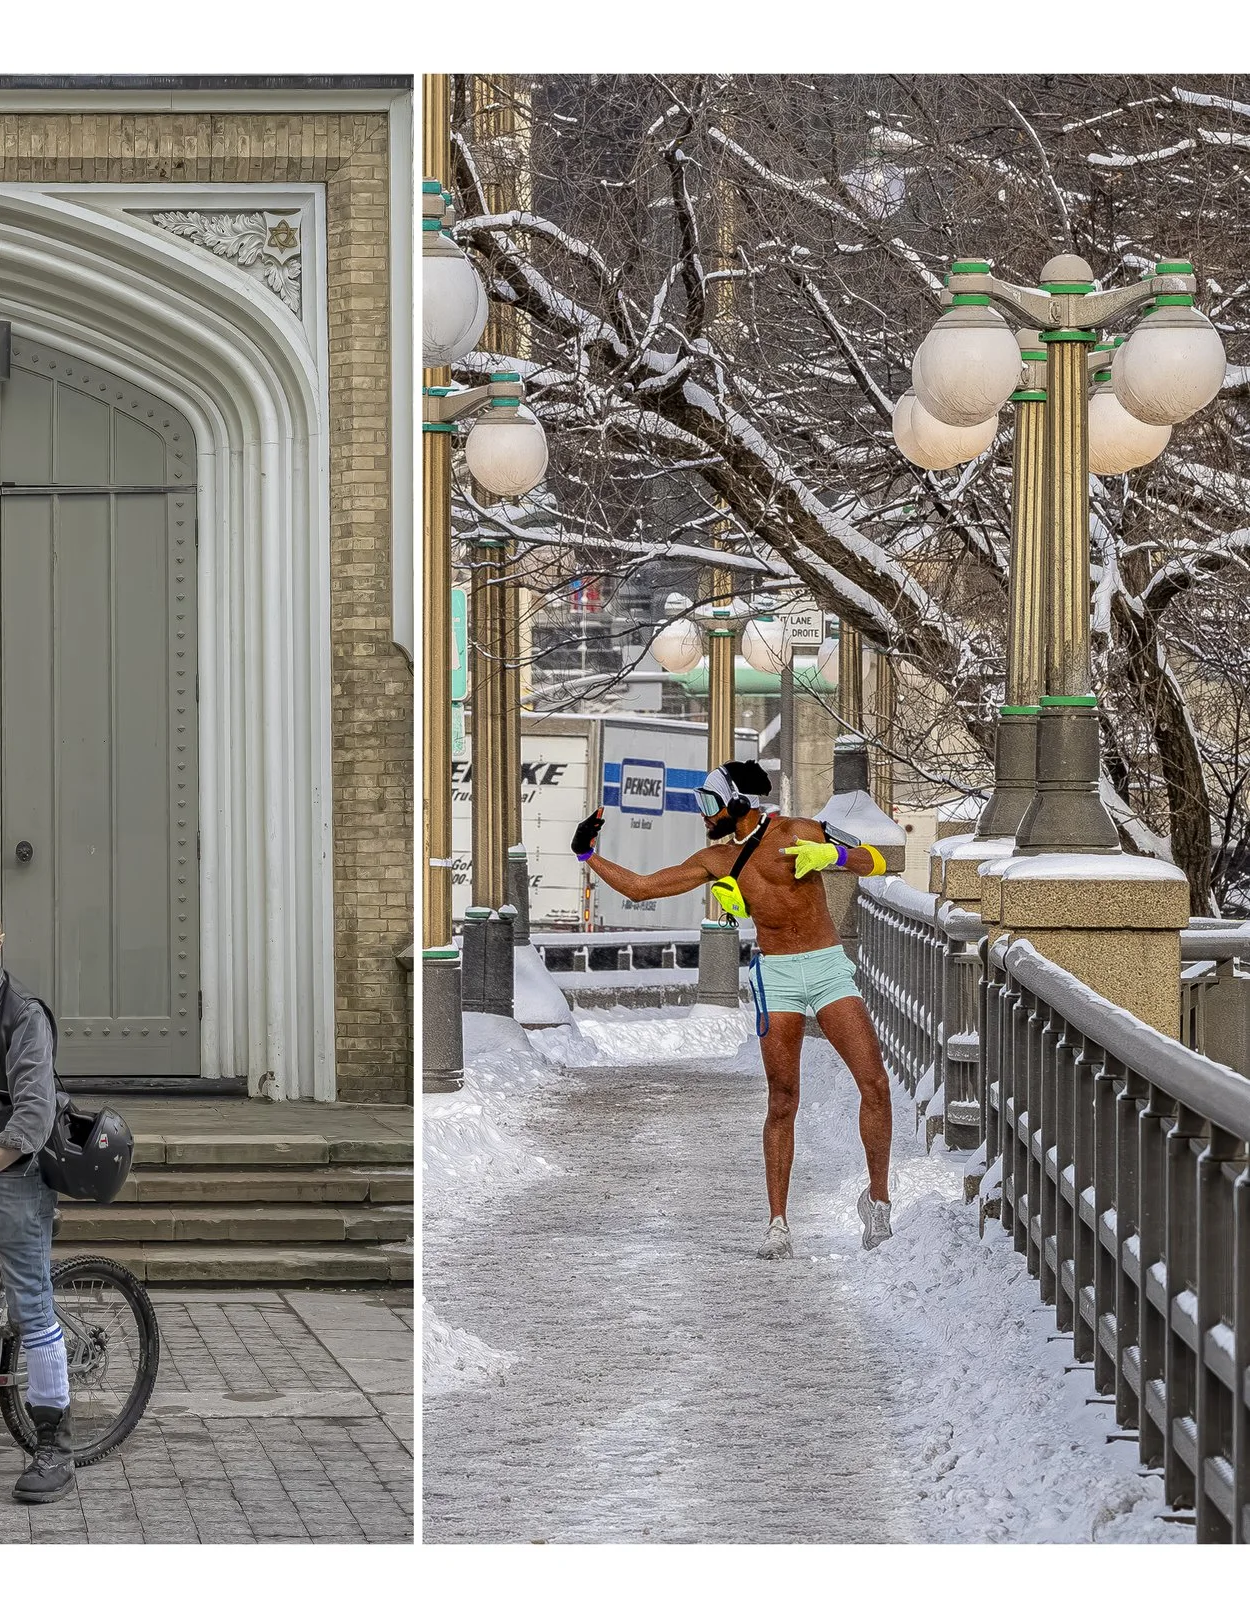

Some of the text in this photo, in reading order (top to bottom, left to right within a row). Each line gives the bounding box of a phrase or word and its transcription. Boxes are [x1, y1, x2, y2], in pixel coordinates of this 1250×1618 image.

[790, 616, 812, 625] LANE
[792, 629, 819, 638] DROITE
[623, 777, 662, 797] PENSKE
